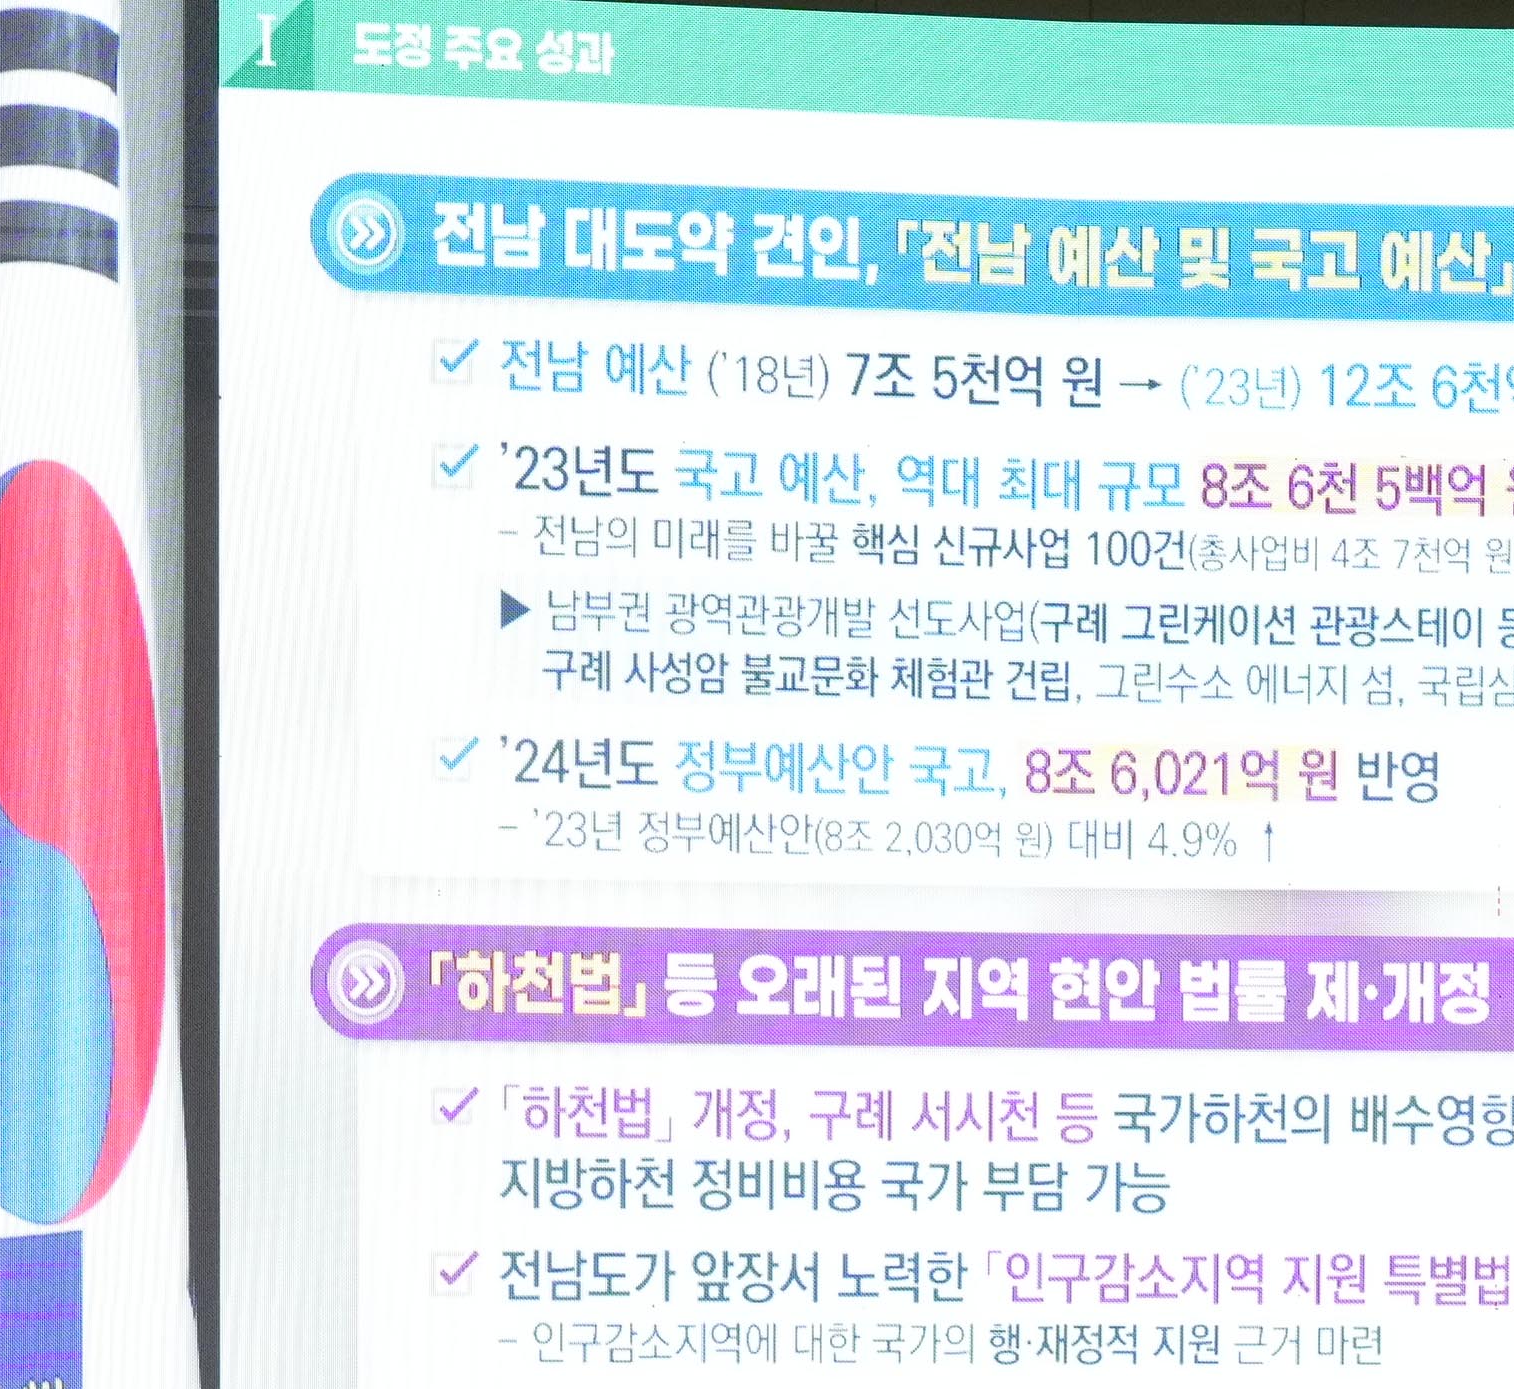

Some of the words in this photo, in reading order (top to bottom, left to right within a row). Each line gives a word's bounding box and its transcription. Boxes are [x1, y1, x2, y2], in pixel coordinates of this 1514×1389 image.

[353, 21, 433, 69] 도정
[443, 24, 523, 73] 주요
[535, 28, 614, 76] 성과
[432, 201, 545, 270] 전남
[564, 204, 735, 277] 대도약
[753, 213, 878, 286] 견인,
[895, 218, 1030, 287] 「전남
[1048, 225, 1159, 289] 예산
[1180, 226, 1230, 290] 및
[1250, 230, 1361, 291] 국고
[1380, 230, 1514, 296] 예산」
[501, 339, 589, 393] 전남
[605, 343, 692, 396] 예산
[846, 352, 916, 398] 7조
[933, 353, 1043, 408] 5천억
[1062, 356, 1102, 409] 원
[1321, 362, 1416, 409] 12조
[675, 449, 763, 501] 국고
[779, 452, 877, 507] 예산,
[896, 455, 980, 509] 역대
[999, 458, 1081, 512] 최대
[1098, 461, 1185, 512] 규모
[1201, 462, 1272, 509] 8조
[1288, 458, 1359, 515] 6천
[1376, 464, 1486, 517] 5백억
[535, 515, 636, 557] 전남의
[654, 518, 756, 561] 미래를
[771, 522, 838, 563] 바꿀
[853, 523, 919, 566] 핵심
[934, 526, 1069, 570] 신규사업
[1088, 530, 1317, 571] 100건(총사업비
[1332, 539, 1378, 569] 4조
[1395, 538, 1470, 573] 7천억
[548, 590, 649, 633] 남부권
[666, 593, 876, 639] 광역관광개발
[890, 599, 1107, 644] 선도사업(구례
[1121, 603, 1296, 646] 그린케이션
[1310, 605, 1483, 648] 관광스테이
[542, 649, 611, 692] 구례
[624, 651, 729, 695] 사성암
[741, 653, 879, 698] 불교문화
[891, 657, 994, 701] 체험관
[1006, 660, 1081, 703] 건립,
[1097, 663, 1233, 703] 그린수소
[1246, 664, 1347, 705] 에너지
[1362, 665, 1404, 706] 섬,
[676, 740, 894, 795] 정부예산안
[910, 746, 1007, 798] 국고,
[1025, 748, 1095, 794] 8조
[1111, 749, 1279, 801] 6,021억
[1299, 749, 1337, 802] 원
[1358, 751, 1438, 804] 반영
[639, 813, 869, 854] 정부예산안(8조
[887, 822, 1000, 857] 2,030억
[1018, 823, 1052, 857] 원)
[1069, 820, 1132, 859] 대비
[1148, 822, 1237, 857] 4.9%
[430, 949, 646, 1020] 「하천법」
[663, 951, 718, 1018] 등
[737, 952, 903, 1020] 오래된
[923, 953, 1029, 1021] 지역
[1049, 957, 1160, 1023] 현안
[1179, 957, 1288, 1023] 법률
[1307, 959, 1490, 1026] 제·개정
[504, 1085, 671, 1142] 「하천법」
[694, 1088, 790, 1141] 개정,
[810, 1090, 892, 1141] 구례
[912, 1091, 1038, 1142] 서시천
[1057, 1093, 1098, 1144] 등
[1114, 1092, 1330, 1145] 국가하천의
[500, 1157, 674, 1210] 지방하천
[693, 1159, 866, 1213] 정비비용
[881, 1160, 968, 1212] 국가
[983, 1161, 1069, 1212] 부담
[1086, 1162, 1170, 1214] 가능
[501, 1249, 676, 1302] 전남도가
[692, 1250, 819, 1304] 앞장서
[838, 1251, 968, 1303] 노력한
[988, 1251, 1263, 1304] 「인구감소지역
[1283, 1253, 1365, 1305] 지원
[533, 1323, 776, 1363] 인구감소지역에
[795, 1324, 860, 1363] 대한
[874, 1324, 974, 1363] 국가의
[989, 1324, 1138, 1365] 행·재정적
[1153, 1324, 1219, 1365] 지원
[1236, 1326, 1300, 1364] 근거
[1317, 1326, 1381, 1365] 마련
